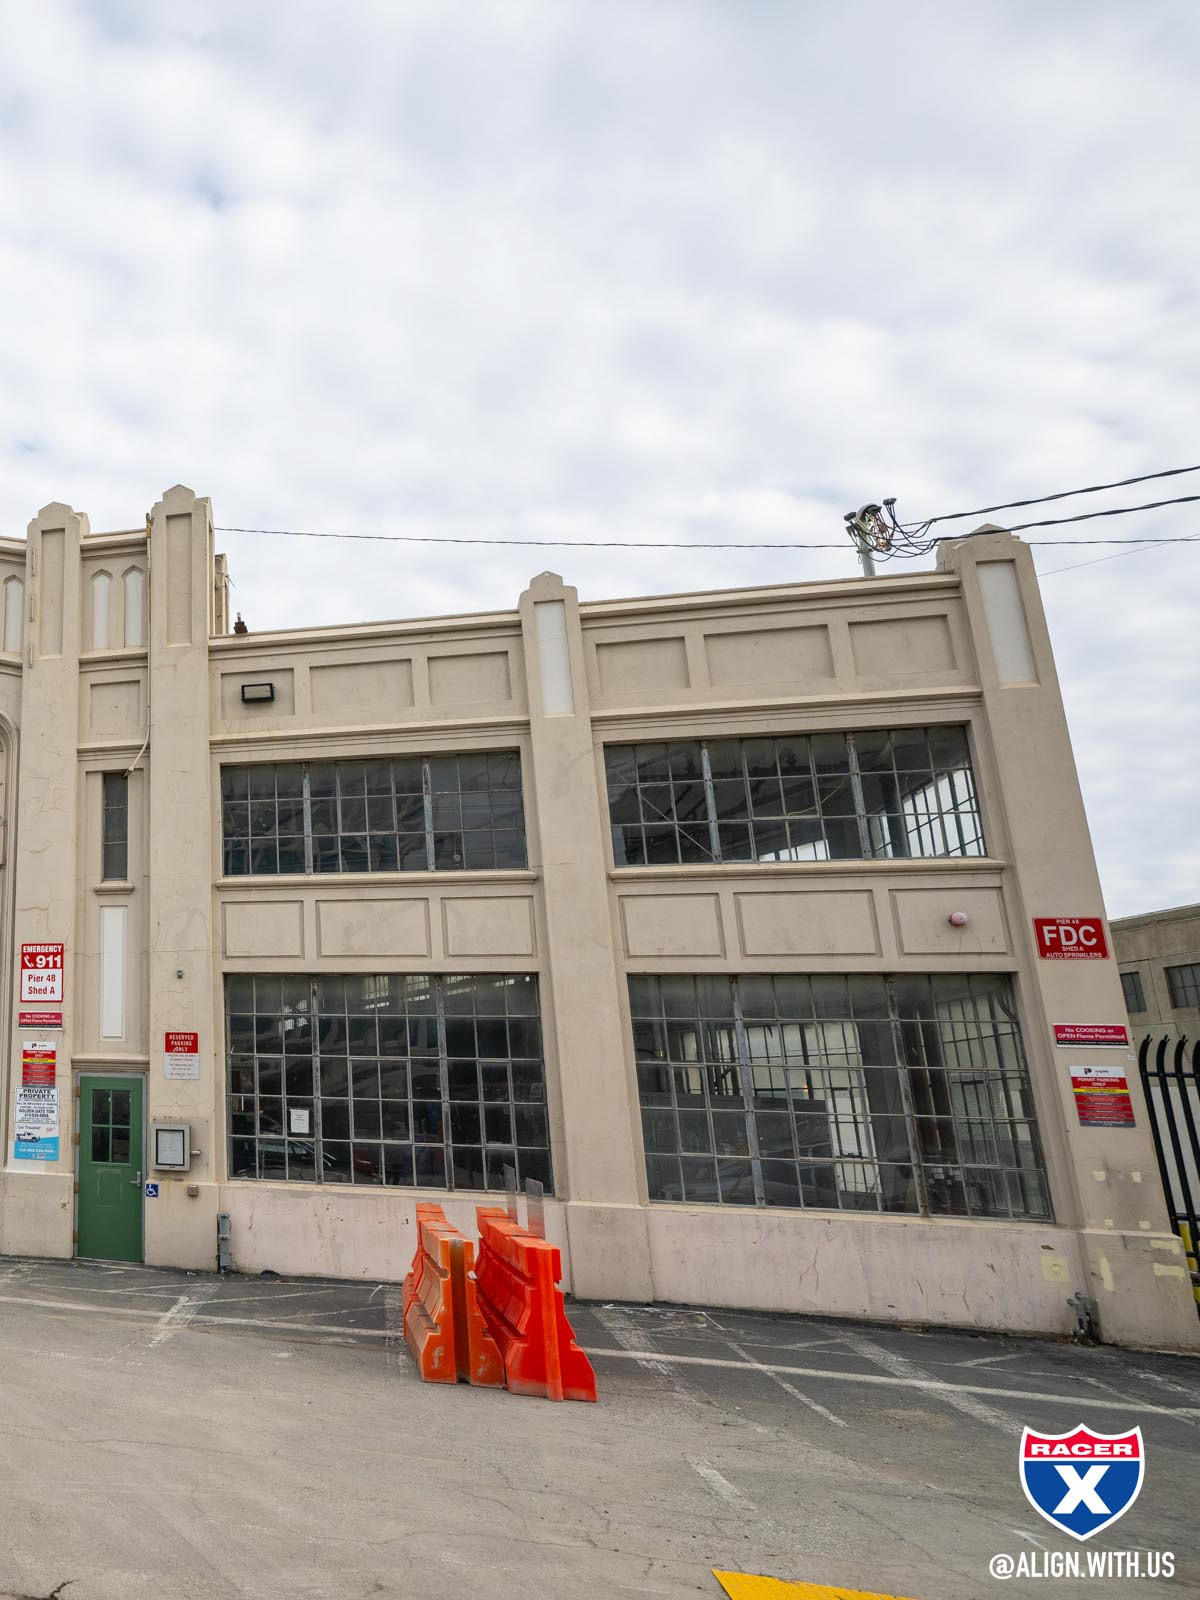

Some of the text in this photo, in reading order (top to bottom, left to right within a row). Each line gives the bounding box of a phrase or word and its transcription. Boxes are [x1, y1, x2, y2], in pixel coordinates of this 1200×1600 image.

[1042, 925, 1097, 946] FDC
[23, 945, 62, 953] EMERGENCY
[35, 955, 62, 968] 911
[28, 974, 56, 983] Pier 48
[28, 986, 55, 994] Shed A
